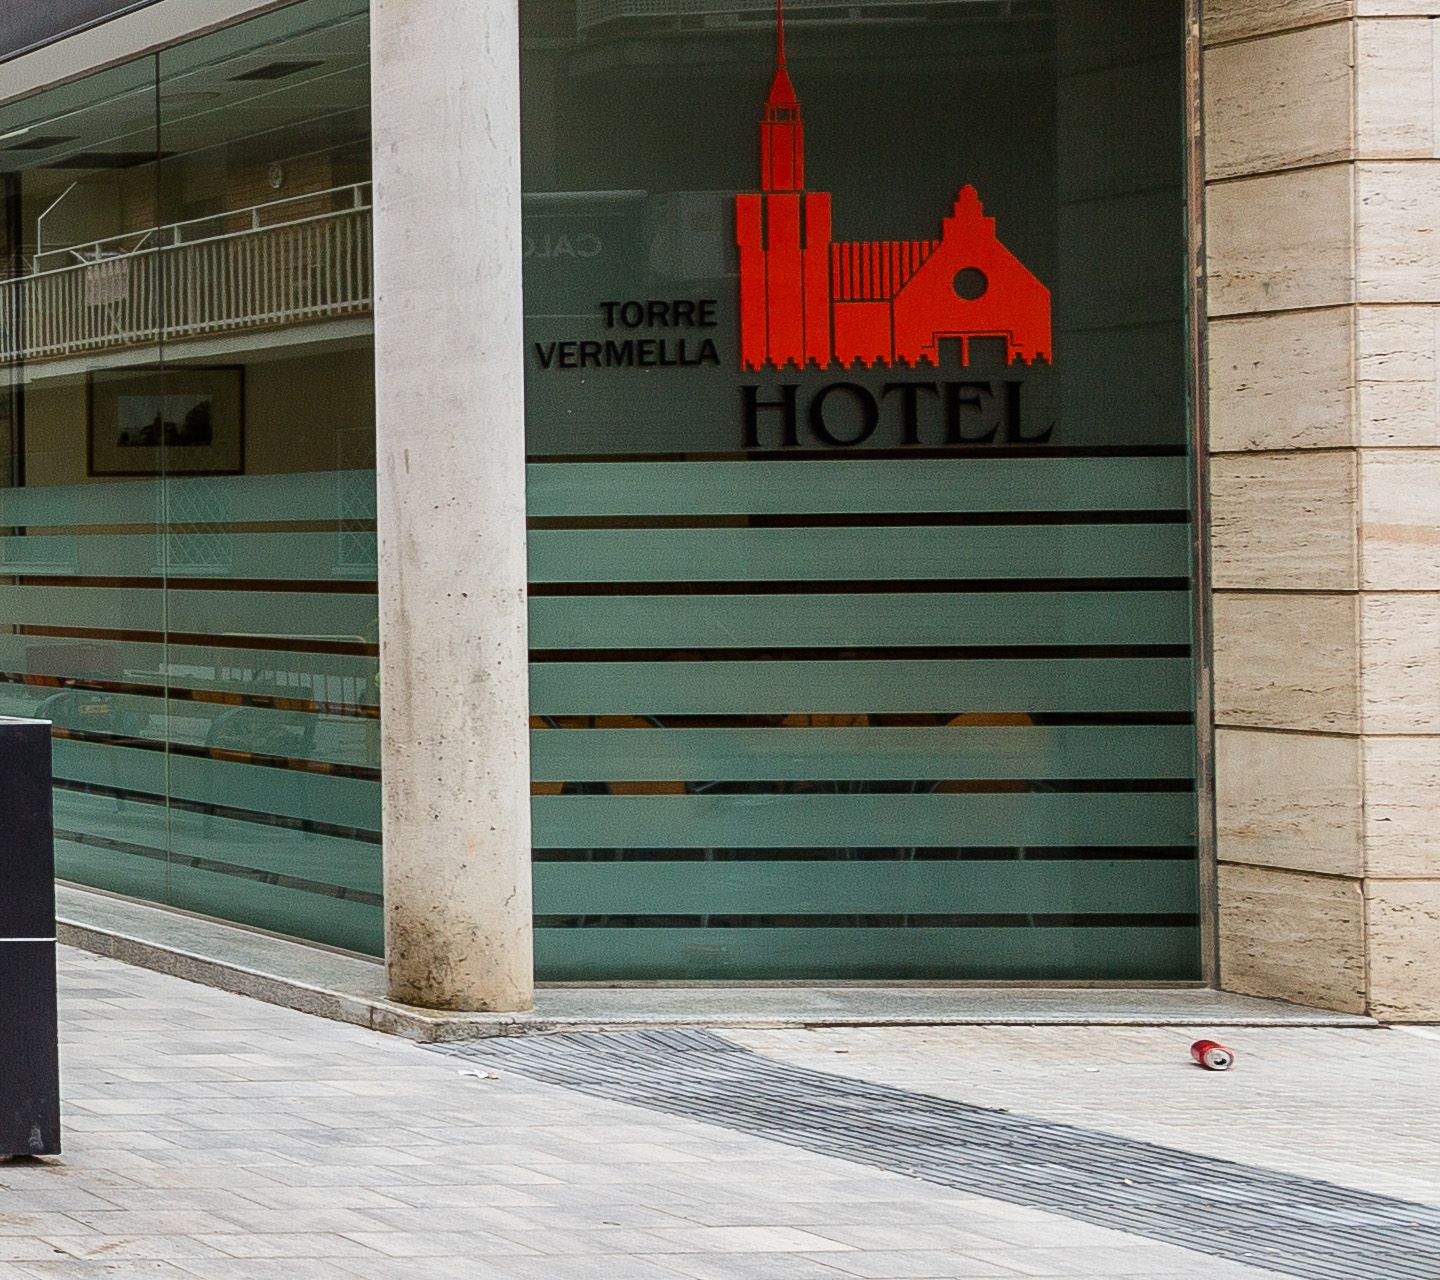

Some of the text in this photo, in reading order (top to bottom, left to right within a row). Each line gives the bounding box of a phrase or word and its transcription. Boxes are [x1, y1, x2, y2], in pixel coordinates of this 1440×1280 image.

[600, 298, 718, 329] TORRE
[533, 337, 721, 369] VERMELLA
[738, 380, 1055, 449] HOTEL
